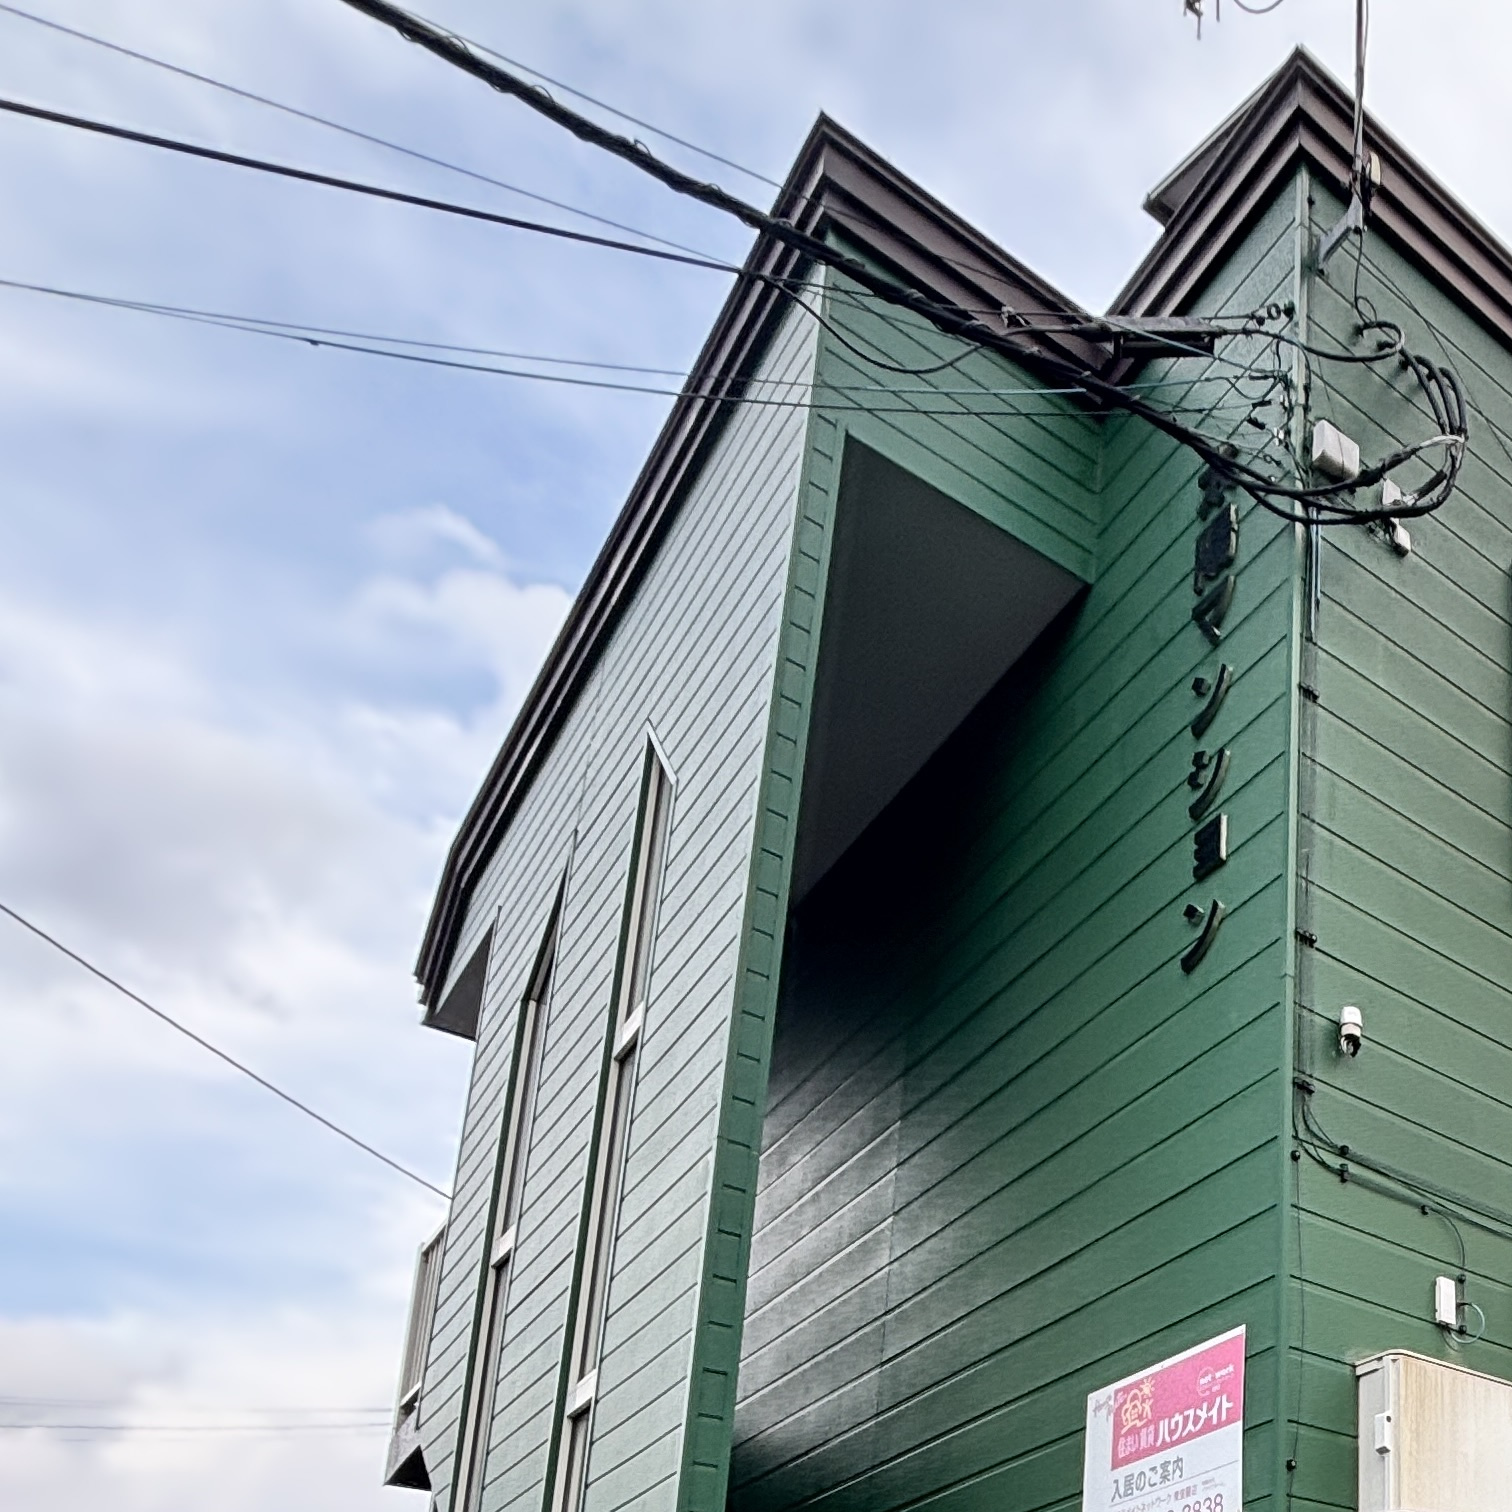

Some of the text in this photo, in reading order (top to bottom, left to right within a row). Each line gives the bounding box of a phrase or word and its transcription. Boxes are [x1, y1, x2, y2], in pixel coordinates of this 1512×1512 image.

[1155, 1394, 1233, 1447] ハウスメイト
[1111, 1456, 1184, 1502] 入居のご案内
